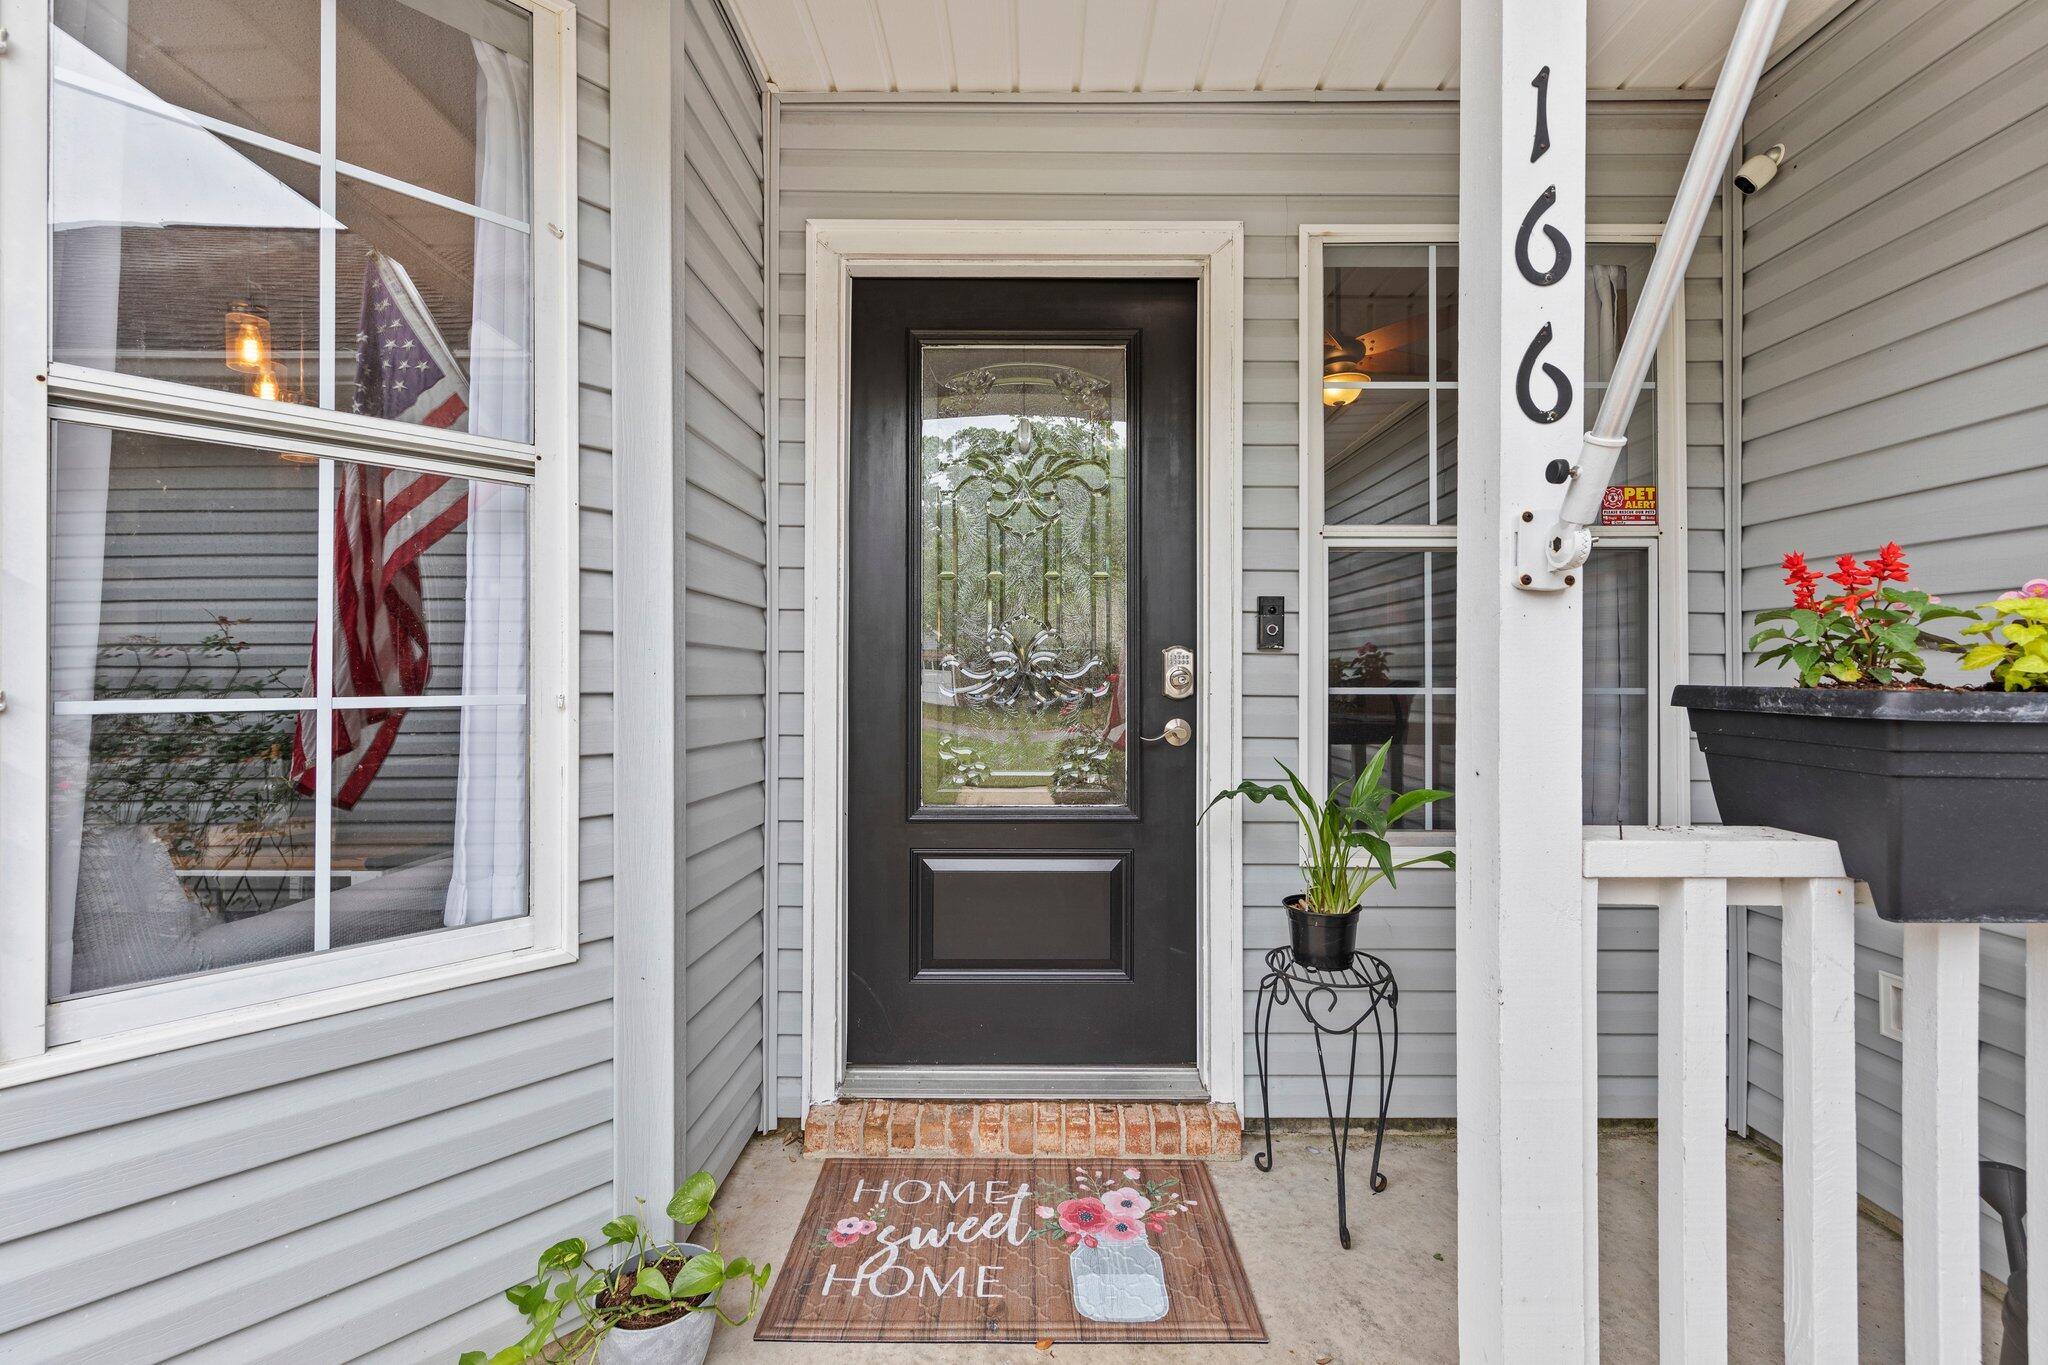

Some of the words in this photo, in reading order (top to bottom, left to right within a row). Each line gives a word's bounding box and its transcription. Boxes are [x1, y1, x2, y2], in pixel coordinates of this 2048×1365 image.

[1515, 65, 1573, 424] 166
[1624, 487, 1655, 500] PET
[1625, 501, 1655, 509] ALERT
[852, 1178, 1010, 1205] HOME
[859, 1182, 1033, 1280] sweet
[821, 1264, 1005, 1298] HOME
